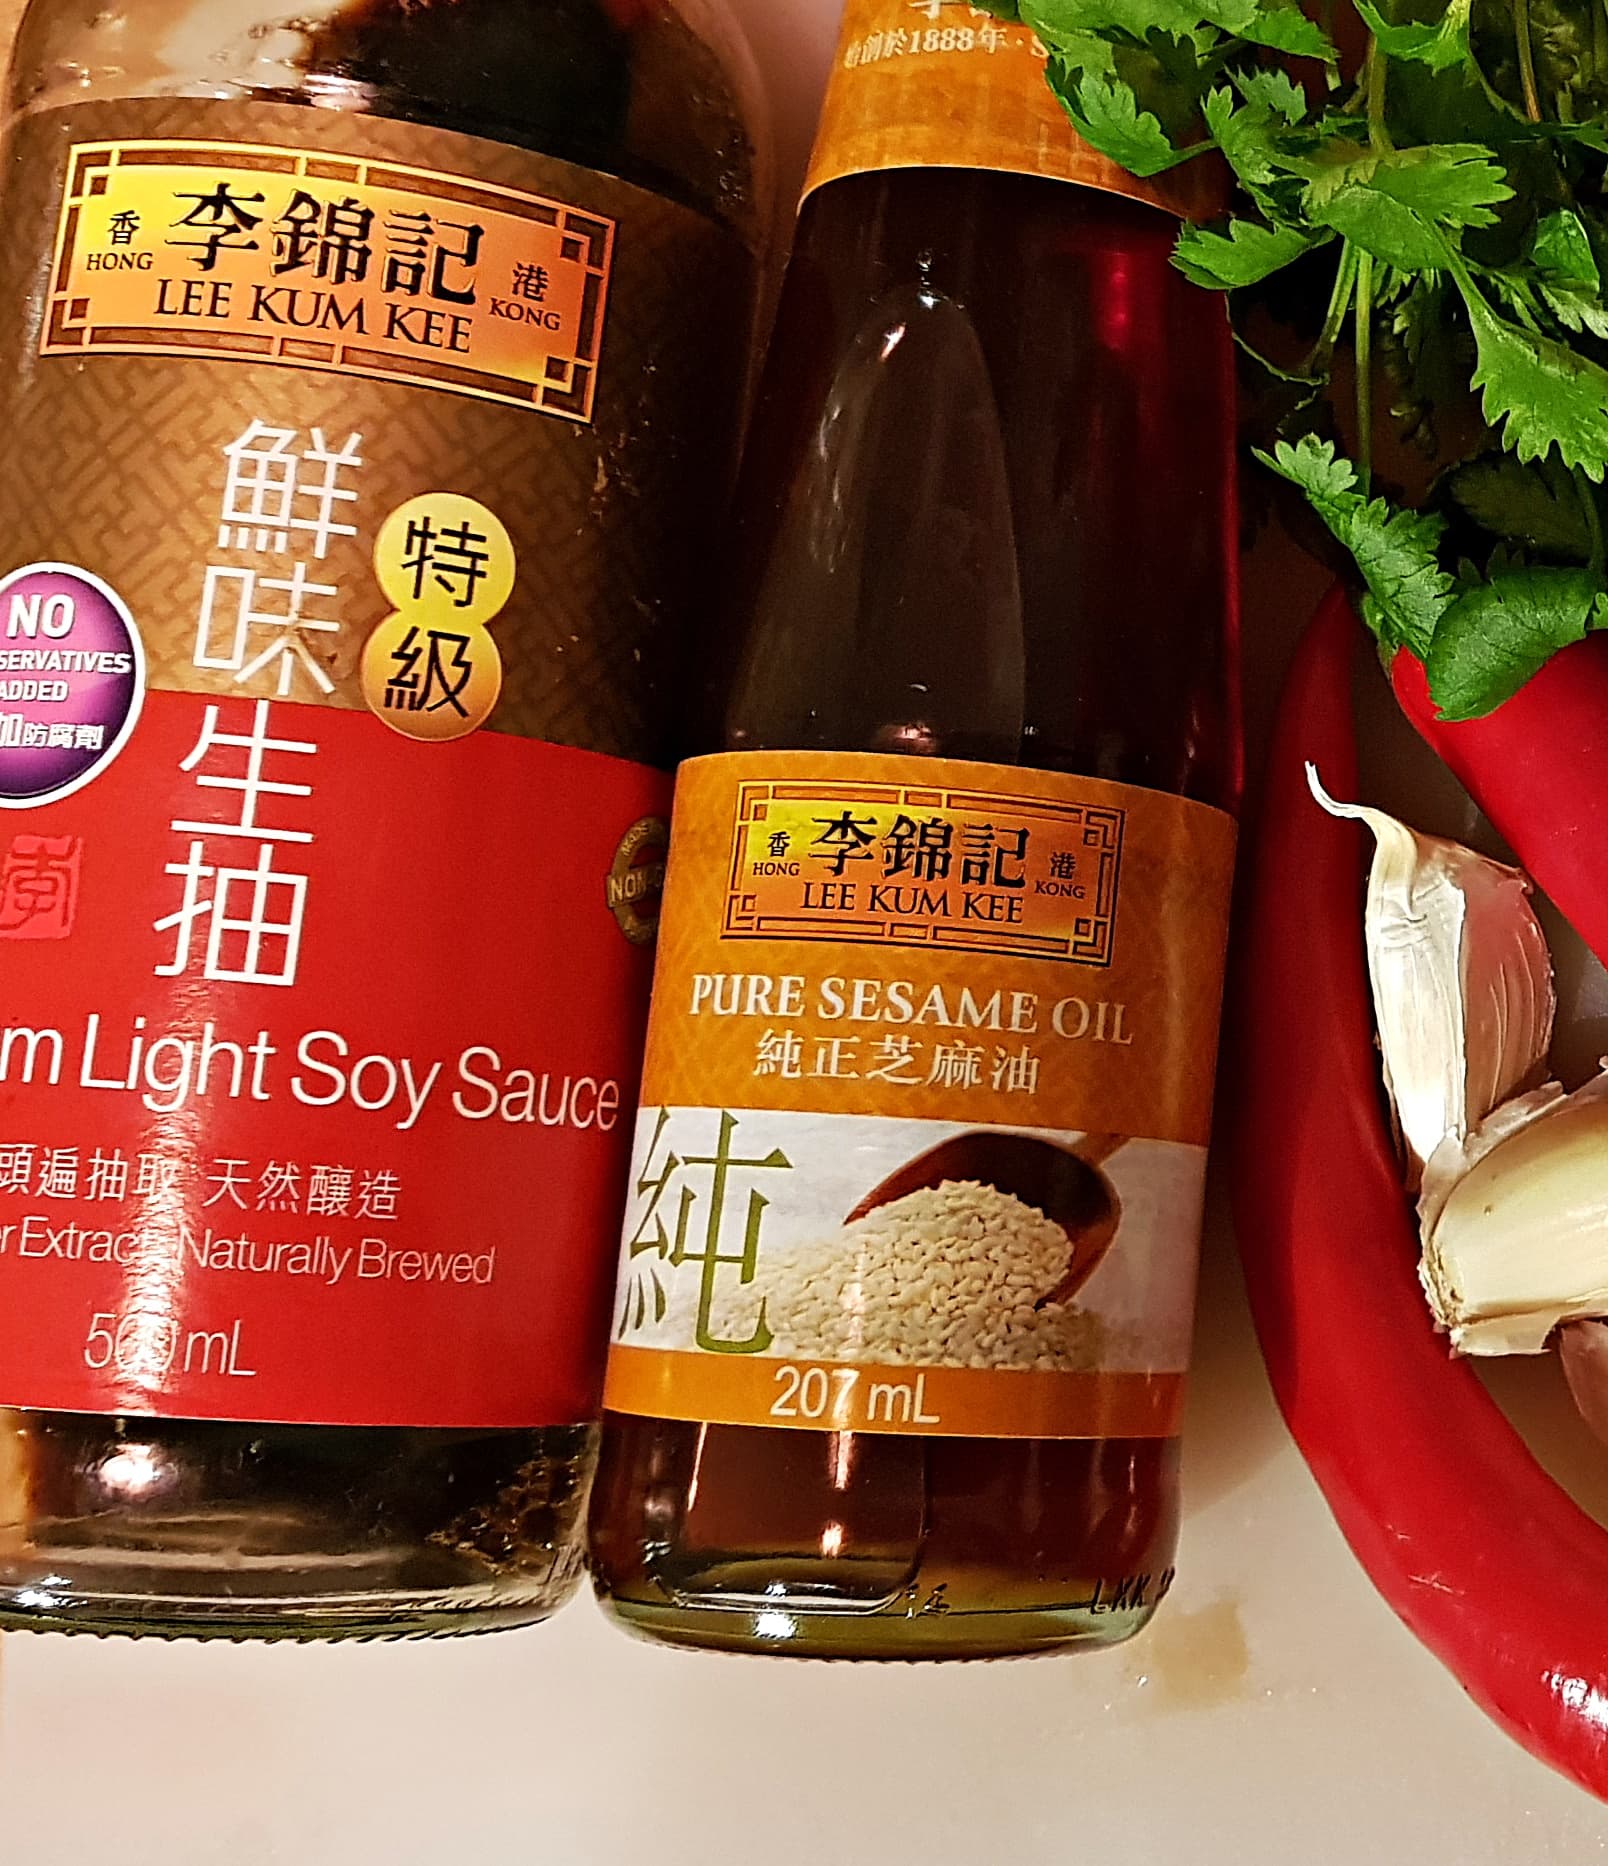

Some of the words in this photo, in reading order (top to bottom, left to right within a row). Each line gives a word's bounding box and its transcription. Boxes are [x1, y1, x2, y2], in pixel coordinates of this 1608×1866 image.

[108, 209, 138, 246] 香
[165, 182, 485, 306] 李錦記
[86, 250, 153, 272] HONG
[512, 262, 549, 297] 港
[154, 279, 231, 319] LEE
[252, 286, 366, 334] KUM
[383, 307, 472, 354] KEE
[489, 298, 561, 331] KONG
[6, 594, 75, 639] NO
[385, 515, 490, 717] 特級
[0, 680, 68, 701] ADDED
[154, 418, 363, 987] 鮮味生抽
[752, 861, 800, 878] HONG
[767, 831, 791, 858] 香
[809, 810, 1028, 889] 李錦記
[1049, 851, 1076, 878] 港
[800, 882, 855, 911] LEE
[868, 886, 952, 920] KUM
[963, 894, 1024, 924] KEE
[1034, 881, 1085, 900] KONG
[690, 974, 804, 1018] PURE
[817, 976, 1038, 1035] SESAME
[1052, 998, 1133, 1046] OIL
[80, 1014, 276, 1112] Light
[291, 1031, 441, 1129] Soy
[453, 1047, 619, 1130] Sauce
[753, 1028, 1041, 1095] 純正芝麻油
[202, 1158, 402, 1220] 天然釀造
[19, 1216, 150, 1265] Extrac
[178, 1227, 352, 1285] Naturally
[358, 1238, 495, 1284] Brewed
[617, 1109, 793, 1354] 純
[184, 1320, 256, 1376] mL
[770, 1367, 857, 1419] 207
[869, 1375, 940, 1425] mL
